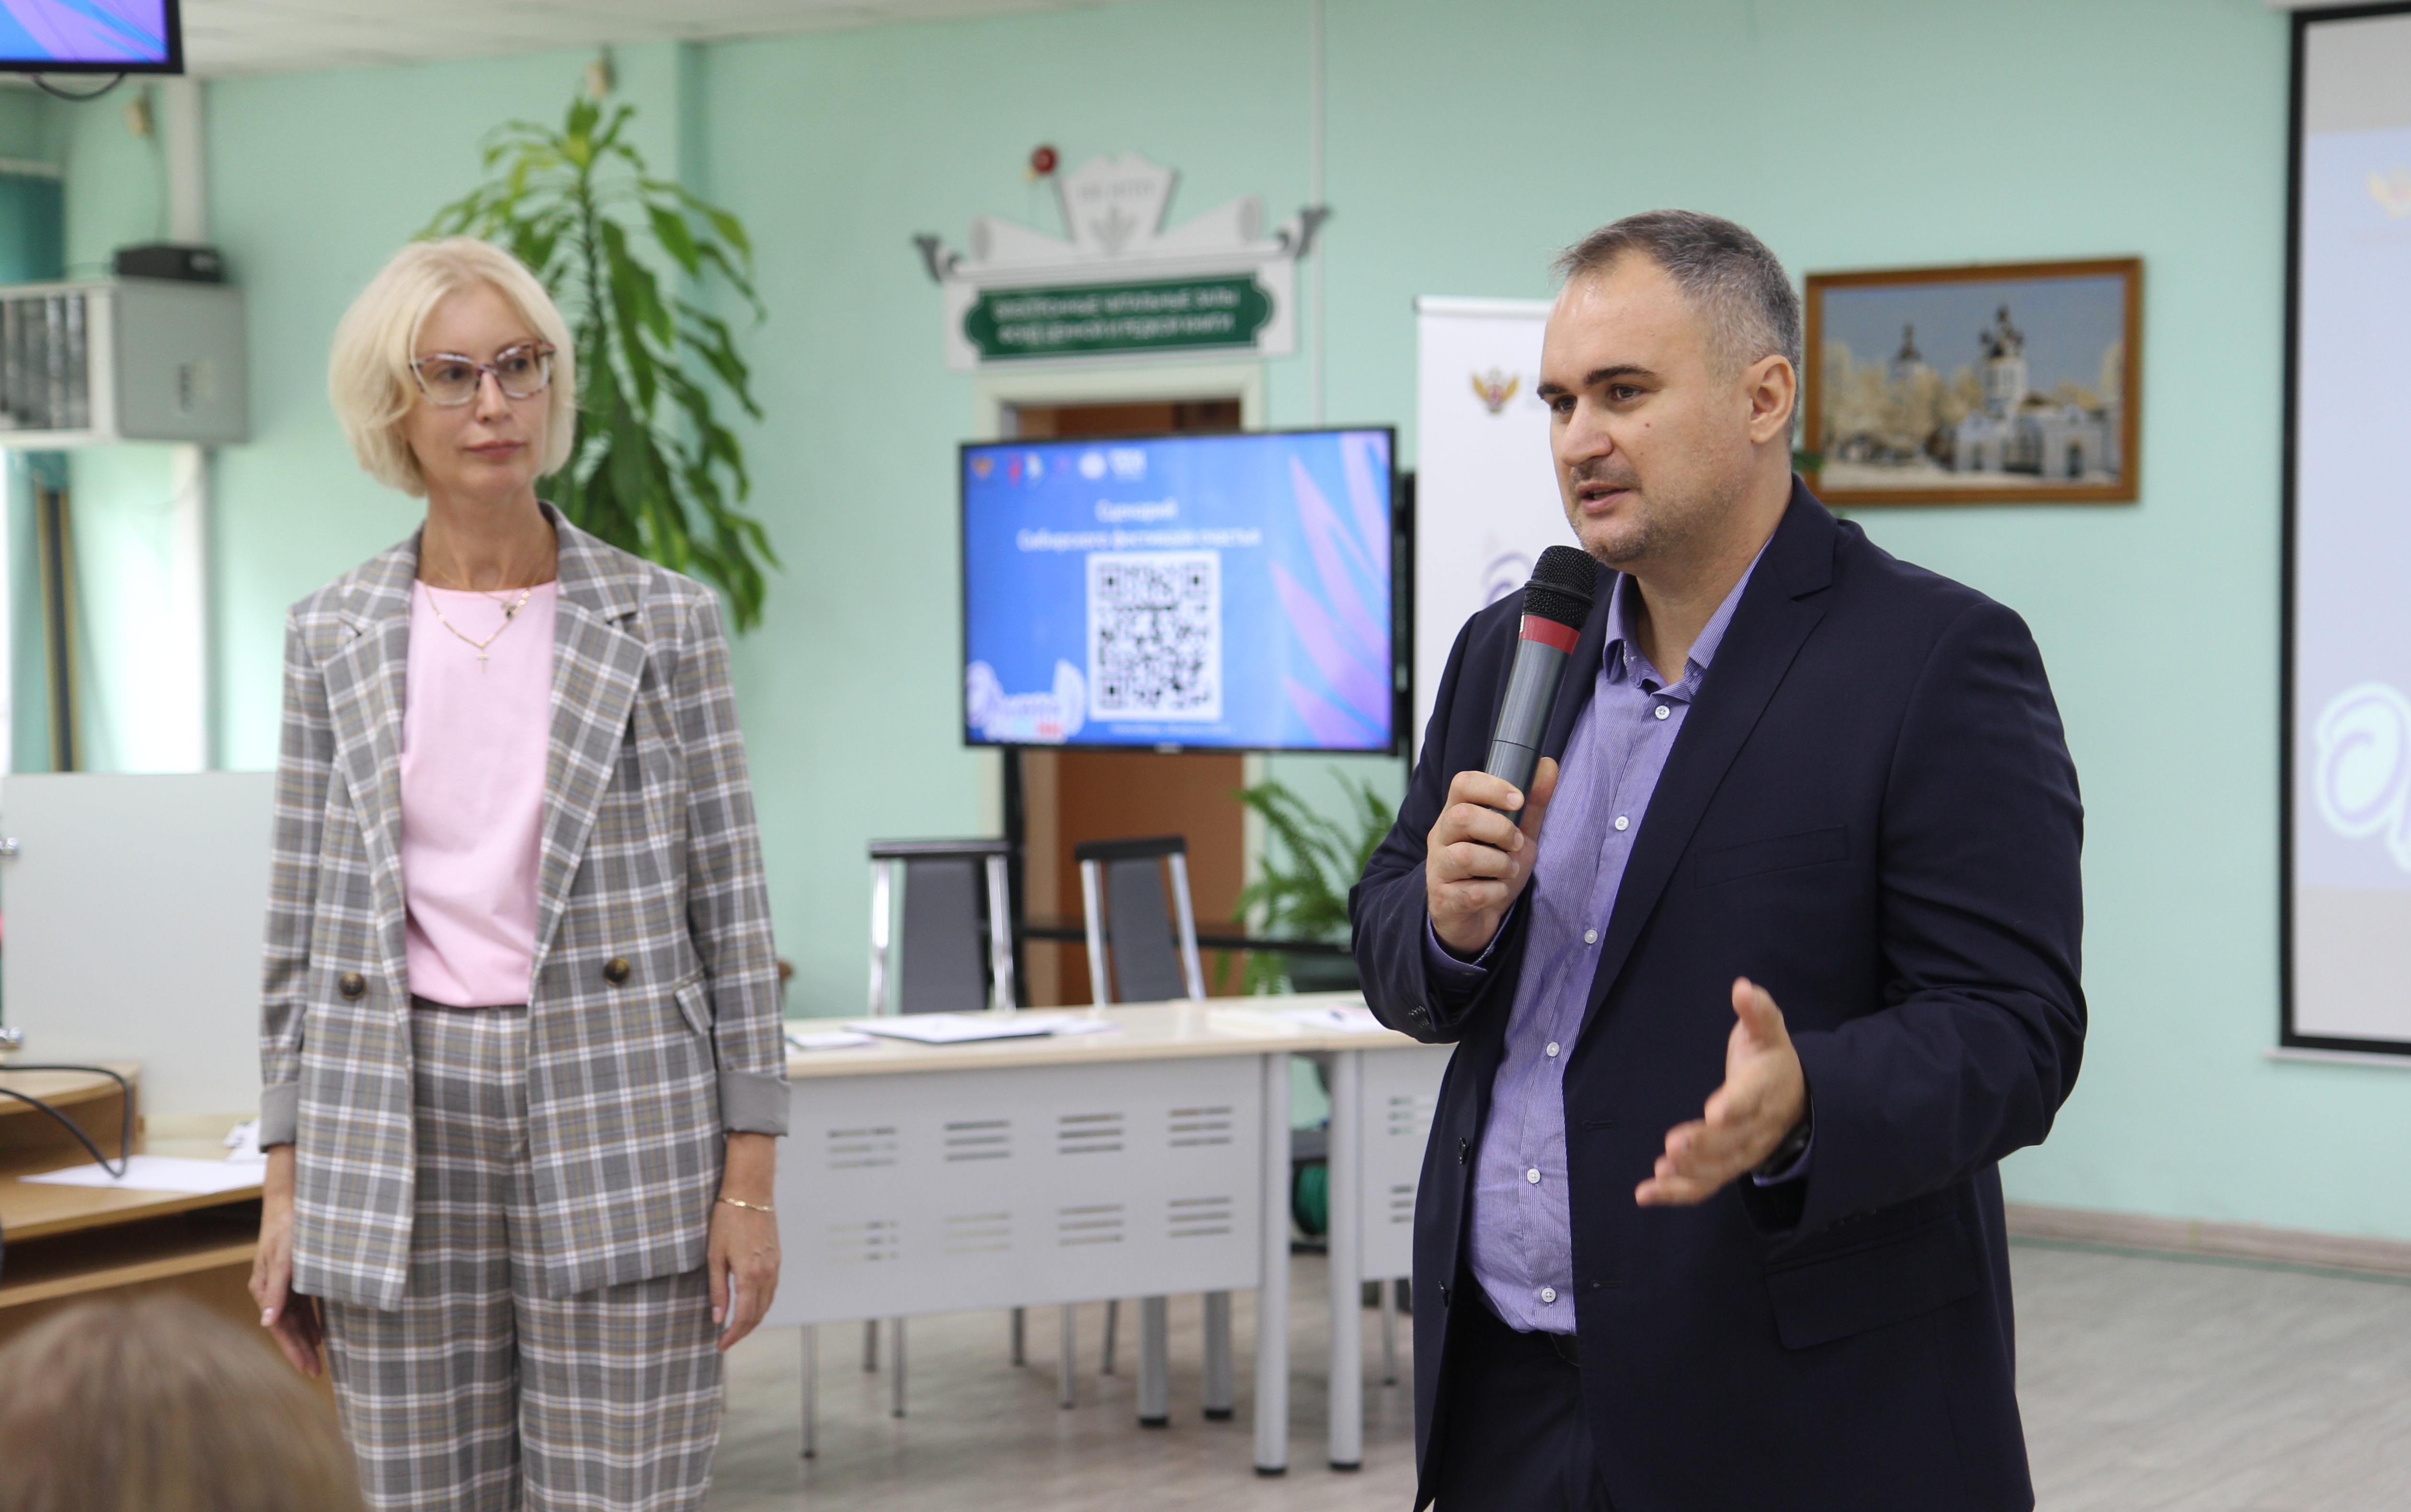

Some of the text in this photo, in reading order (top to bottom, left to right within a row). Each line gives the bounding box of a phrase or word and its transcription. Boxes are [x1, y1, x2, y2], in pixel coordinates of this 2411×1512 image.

[992, 296, 1101, 321] ЭЛЕКТРОННЫЕ
[1100, 290, 1193, 314] ЧИТАЛЬНЫЕ
[1096, 498, 1178, 525] Сценарий
[1017, 527, 1261, 553] Сибирского фестиваля счастья
